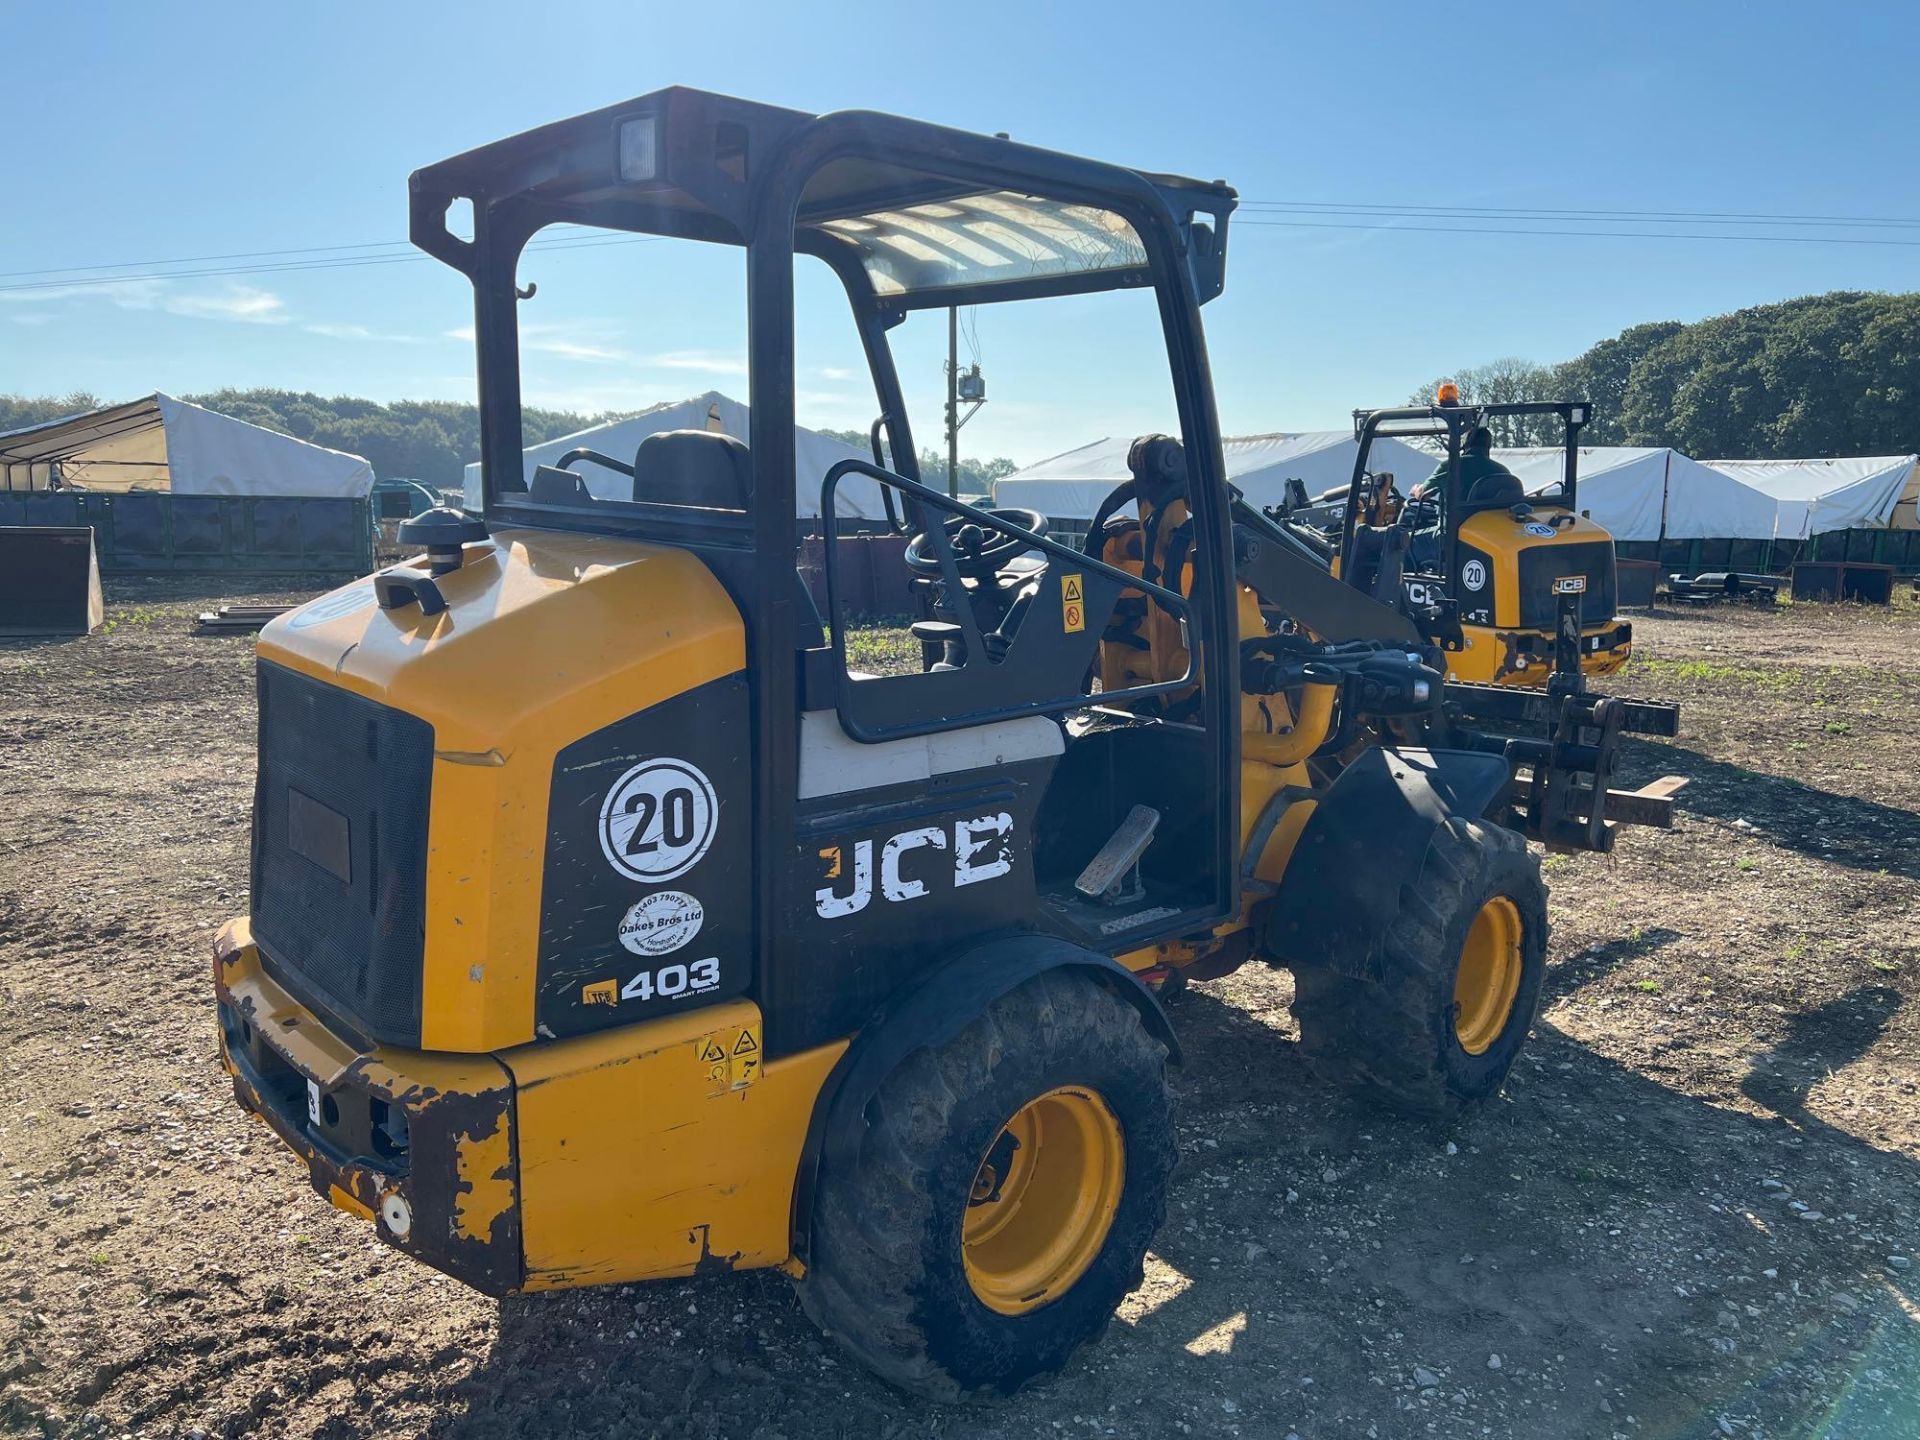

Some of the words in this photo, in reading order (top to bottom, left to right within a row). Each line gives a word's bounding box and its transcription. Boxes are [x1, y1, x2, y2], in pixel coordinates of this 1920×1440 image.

[1528, 526, 1552, 534] 20
[1467, 567, 1481, 584] 20
[1554, 579, 1584, 590] JCB
[625, 788, 695, 856] 20
[815, 812, 1014, 919] JCB
[634, 896, 658, 918] 01403
[619, 921, 654, 935] Oakes
[657, 916, 682, 928] Bros
[685, 910, 702, 922] Ltd
[621, 957, 720, 1001] 403
[672, 990, 696, 1000] SMART
[697, 984, 720, 994] POWER
